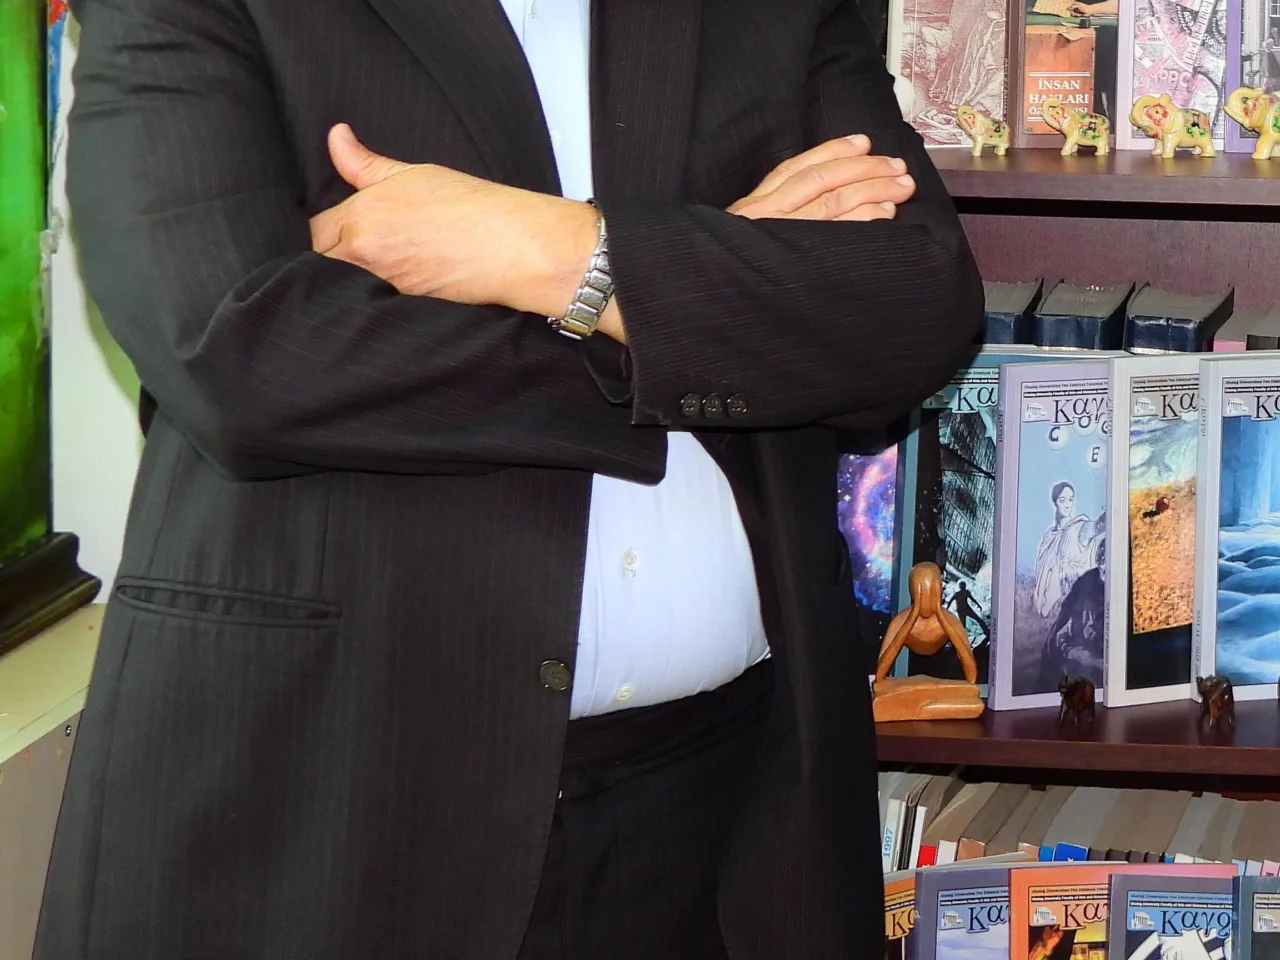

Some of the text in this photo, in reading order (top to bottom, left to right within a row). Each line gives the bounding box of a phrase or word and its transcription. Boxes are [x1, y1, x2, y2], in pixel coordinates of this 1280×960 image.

[1038, 78, 1081, 90] İNSAN
[1029, 93, 1089, 104] HALARI
[883, 827, 893, 857] 1997
